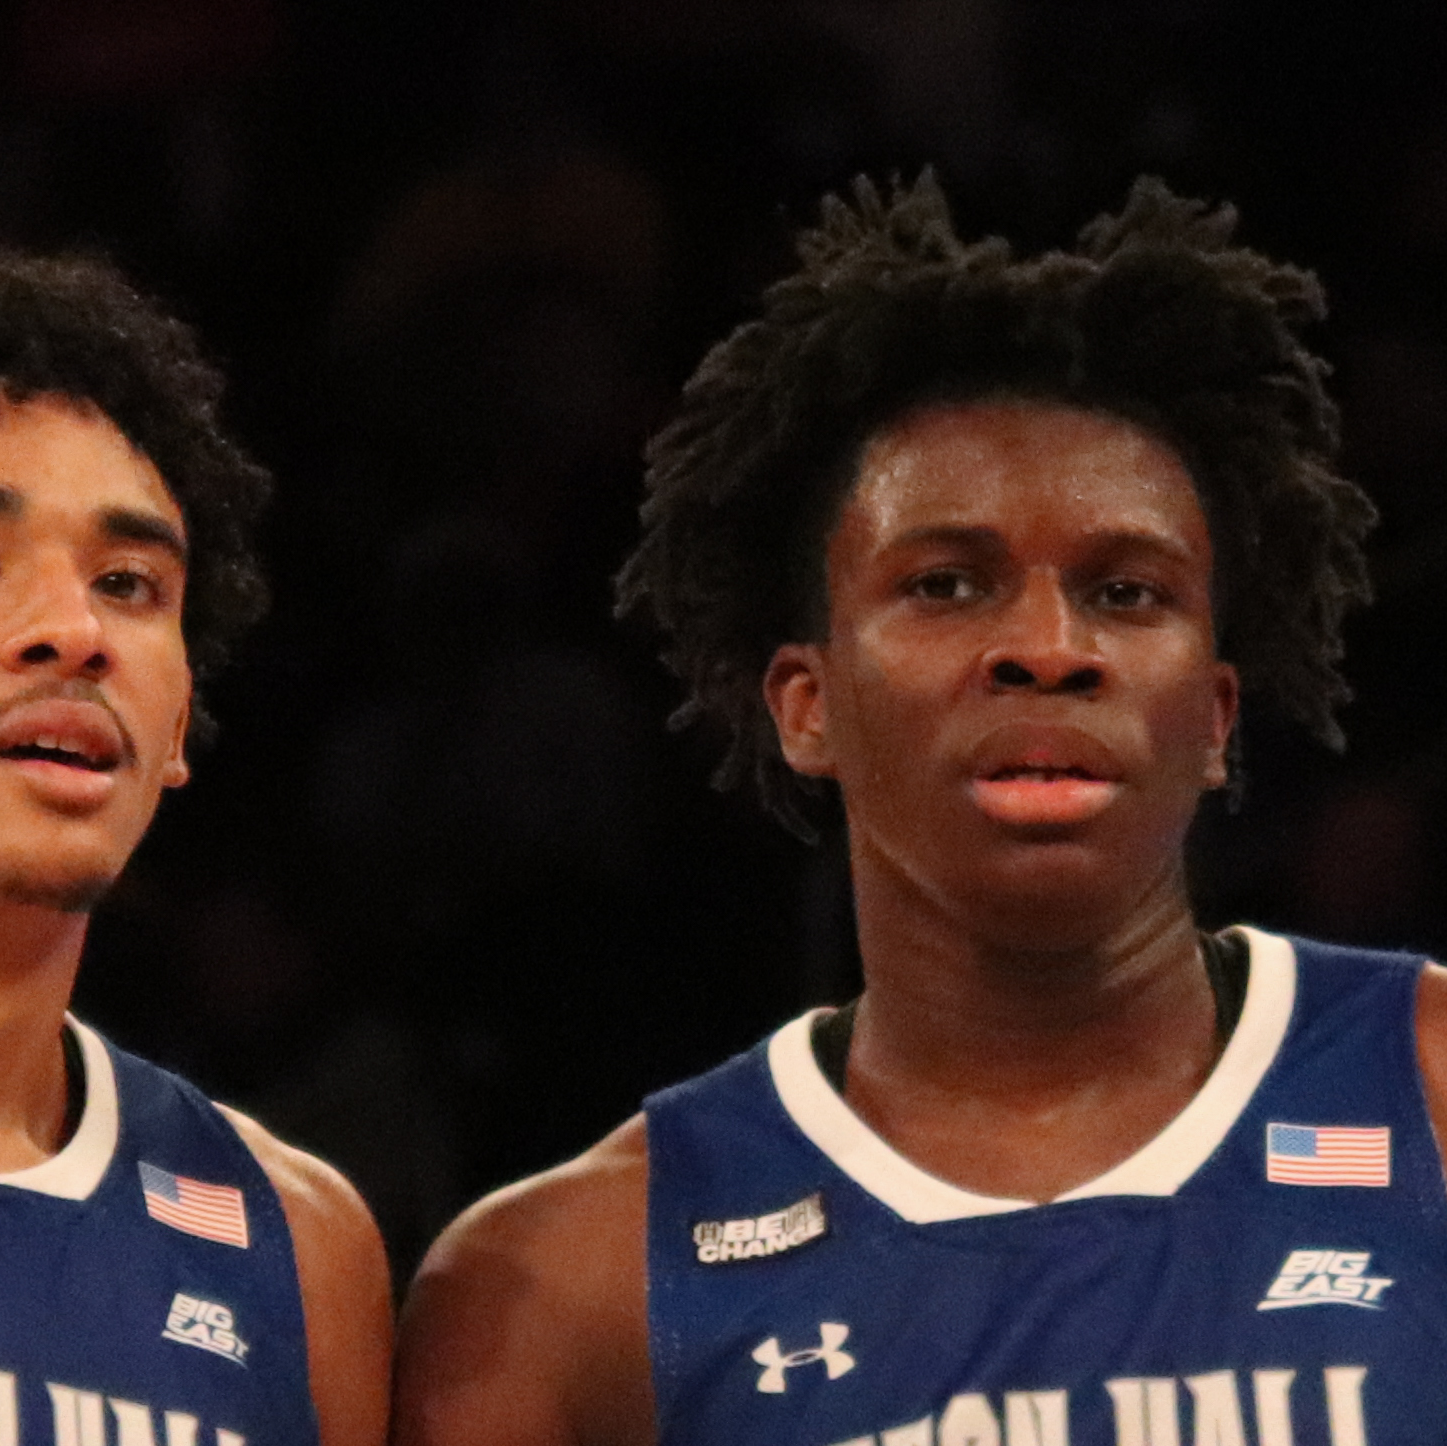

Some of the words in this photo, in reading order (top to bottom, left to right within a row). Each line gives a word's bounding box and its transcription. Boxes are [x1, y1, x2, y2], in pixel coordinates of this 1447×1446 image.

[723, 1211, 787, 1243] BE
[1280, 1249, 1371, 1276] BIG
[1266, 1274, 1394, 1300] EAST
[170, 1292, 234, 1330] BIG
[165, 1311, 249, 1358] EAST
